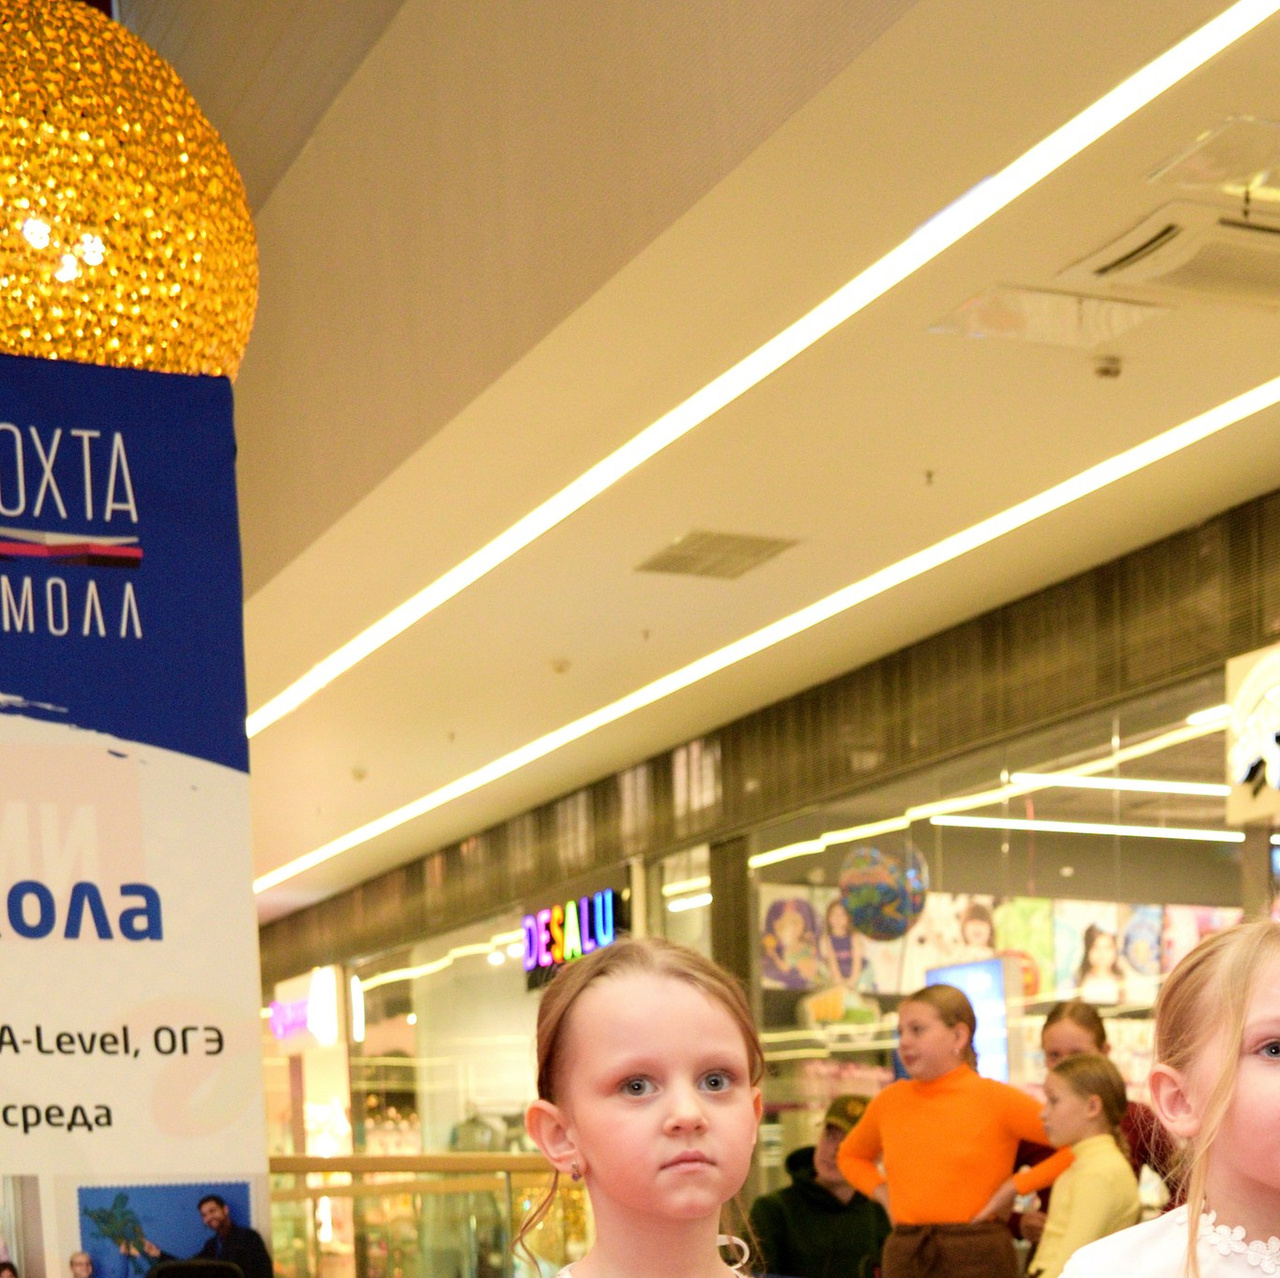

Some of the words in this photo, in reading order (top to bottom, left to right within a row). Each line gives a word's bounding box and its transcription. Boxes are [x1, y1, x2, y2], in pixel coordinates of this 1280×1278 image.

[0, 879, 164, 942] ола
[522, 888, 614, 972] DESALU
[0, 1024, 140, 1058] A-Level,
[153, 1026, 225, 1056] ОГЭ
[2, 1103, 113, 1135] среда
